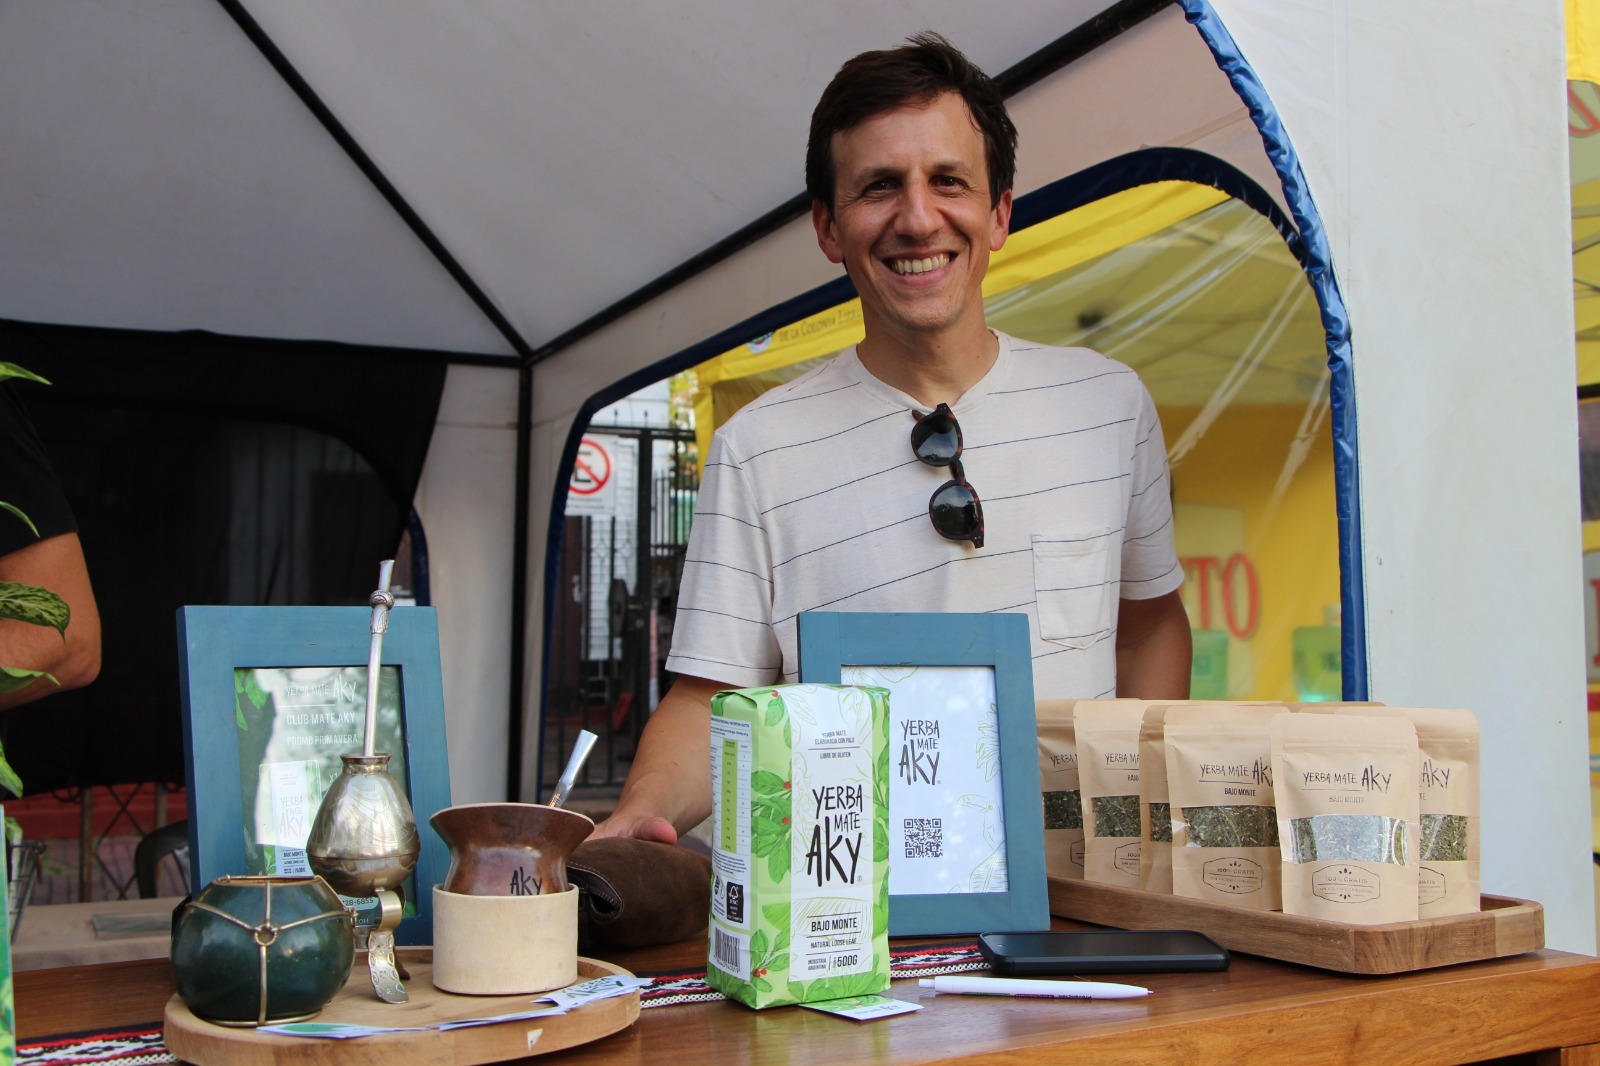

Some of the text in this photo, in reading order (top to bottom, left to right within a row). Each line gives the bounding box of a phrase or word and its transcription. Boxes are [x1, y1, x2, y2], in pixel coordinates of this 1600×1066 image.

[333, 674, 356, 702] AKY
[286, 711, 356, 725] CLUB MATE AKY
[901, 719, 940, 741] YERBA
[287, 733, 358, 746] PROMO PRIMAVERA
[917, 737, 938, 750] MATE
[899, 739, 940, 785] AKY
[1051, 754, 1075, 768] YERBA
[1105, 753, 1128, 765] YERBA
[1200, 764, 1226, 777] YERBA
[1228, 764, 1249, 777] MATE
[1421, 759, 1450, 788] AKY
[1303, 765, 1391, 794] YERBA MATE AKY
[812, 784, 863, 819] YERBA
[1329, 795, 1343, 803] BAJO
[279, 809, 304, 838] AKY
[834, 812, 861, 833] MATE
[806, 816, 862, 887] AKY
[510, 866, 543, 895] AKY
[342, 897, 374, 906] 28-6855
[811, 917, 858, 932] BAJO MONTE
[811, 940, 831, 948] NATURAL
[832, 938, 845, 947] LOOSE
[837, 954, 858, 967] 500G
